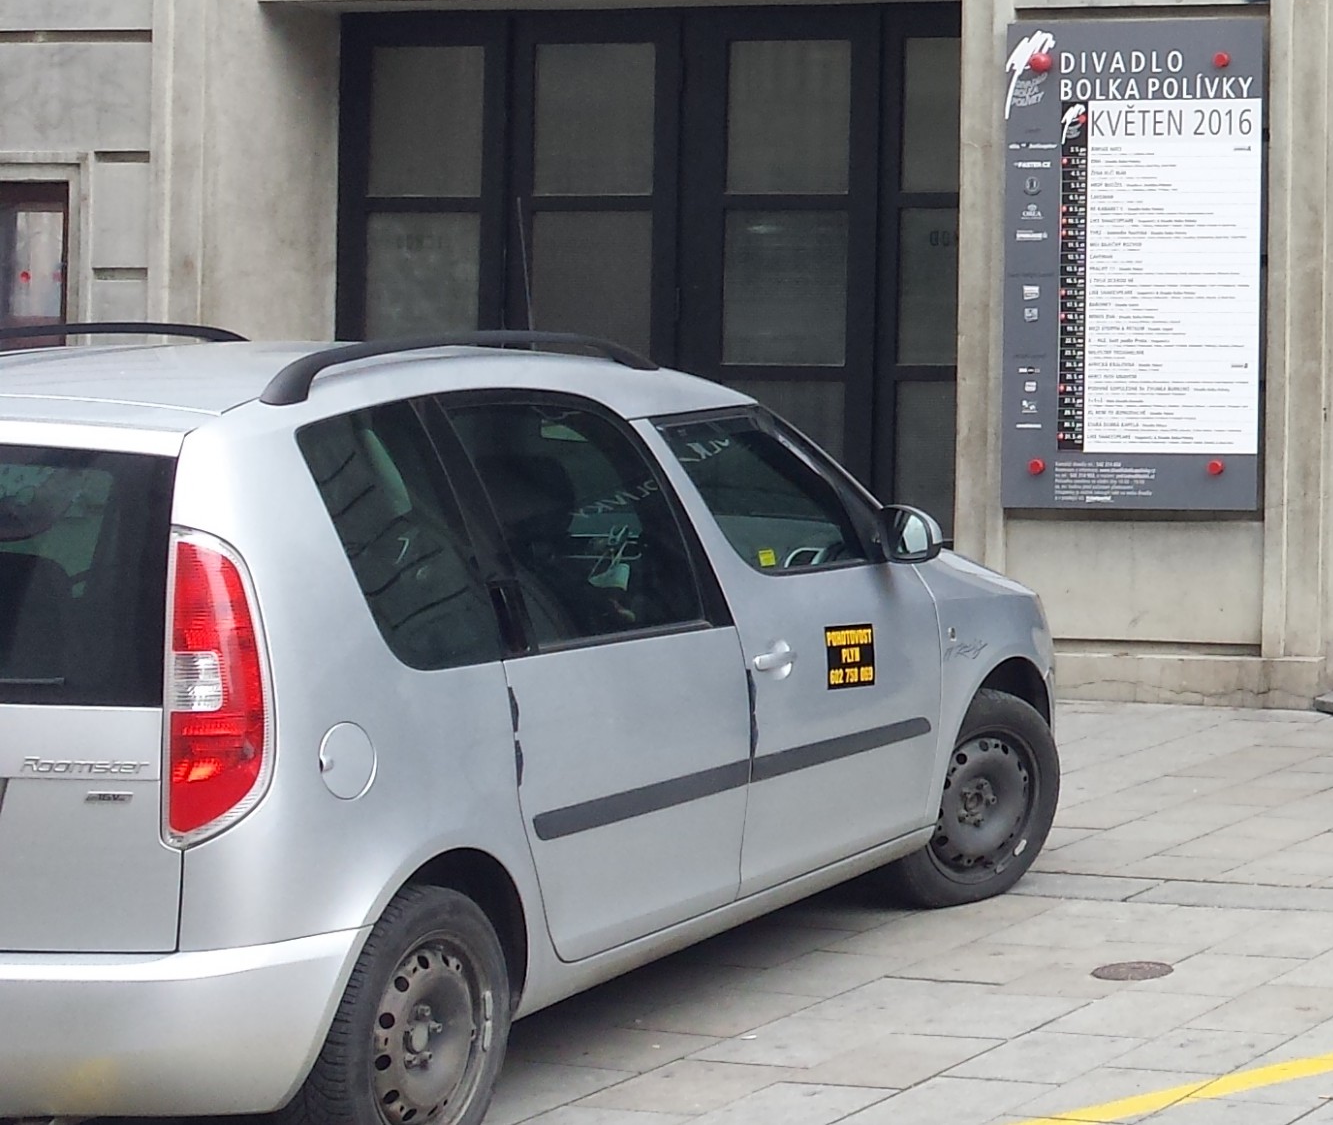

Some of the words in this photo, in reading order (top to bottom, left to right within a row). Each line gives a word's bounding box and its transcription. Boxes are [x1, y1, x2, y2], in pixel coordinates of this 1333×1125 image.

[1059, 50, 1184, 74] DIVADLO
[1059, 78, 1141, 101] BOLKA
[1147, 73, 1254, 100] POLÍVKY
[1090, 104, 1183, 137] KVĚTEN
[1193, 108, 1253, 136] 2016
[20, 755, 151, 774] Roomster
